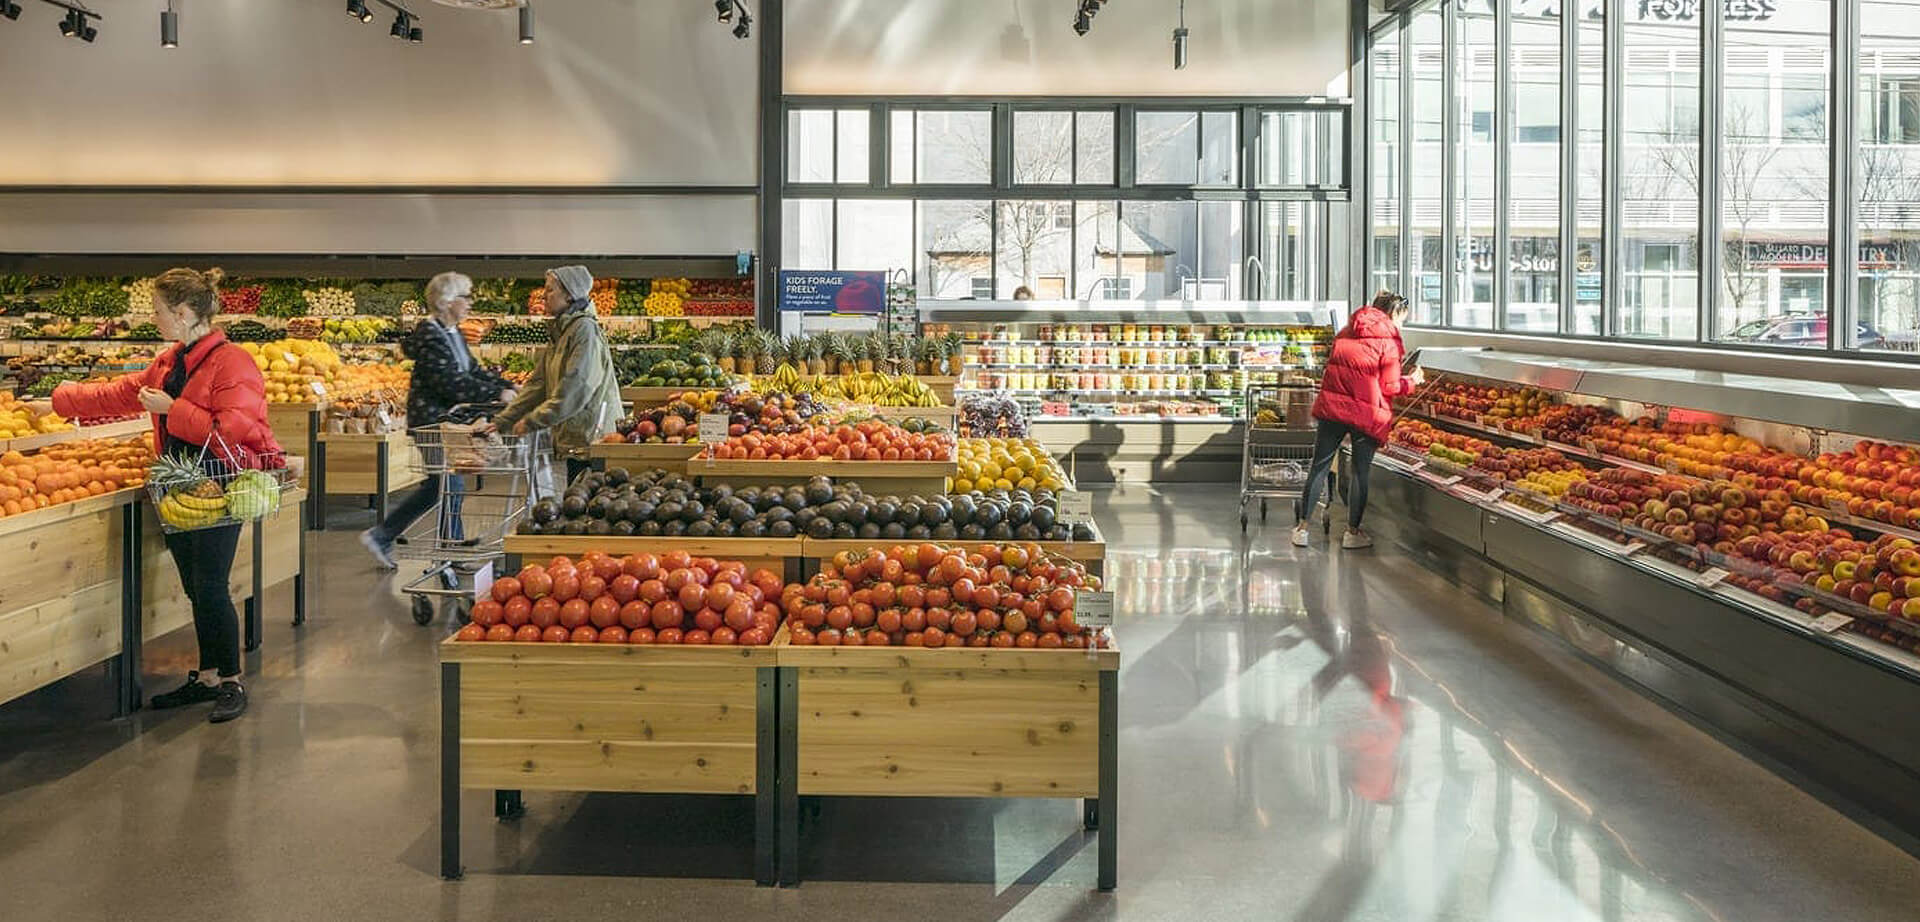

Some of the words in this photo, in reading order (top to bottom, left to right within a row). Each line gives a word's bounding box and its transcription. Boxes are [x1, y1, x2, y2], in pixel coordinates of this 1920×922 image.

[1802, 245, 1889, 261] DETRY
[786, 276, 806, 285] KIDS
[808, 276, 844, 285] FORAGE
[786, 285, 818, 294] FREELY.
